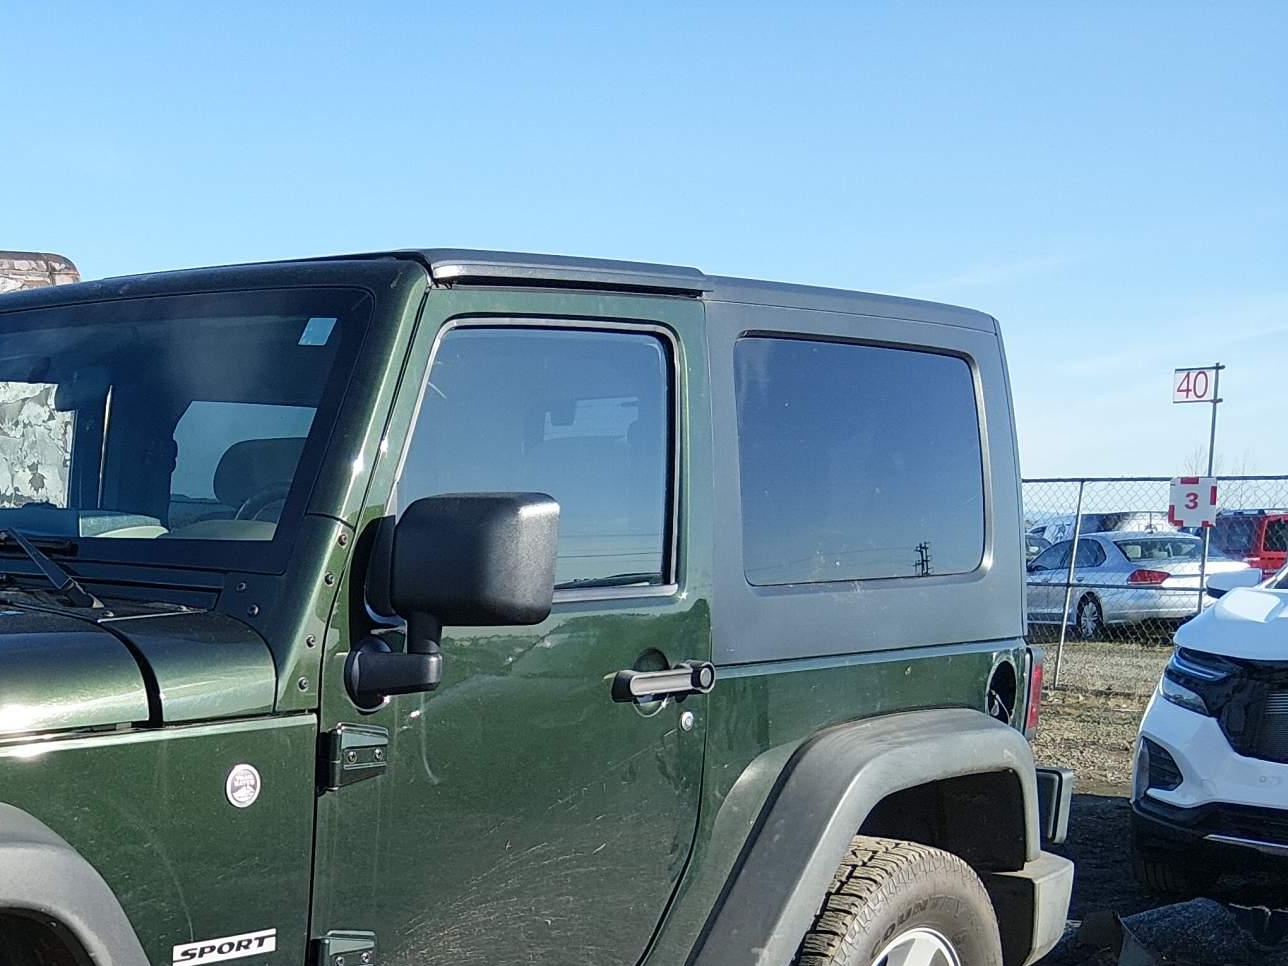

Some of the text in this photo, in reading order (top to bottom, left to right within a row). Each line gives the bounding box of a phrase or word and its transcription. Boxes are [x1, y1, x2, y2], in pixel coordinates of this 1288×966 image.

[1177, 371, 1208, 398] 40
[1185, 493, 1198, 509] 3
[180, 937, 268, 961] SPORT
